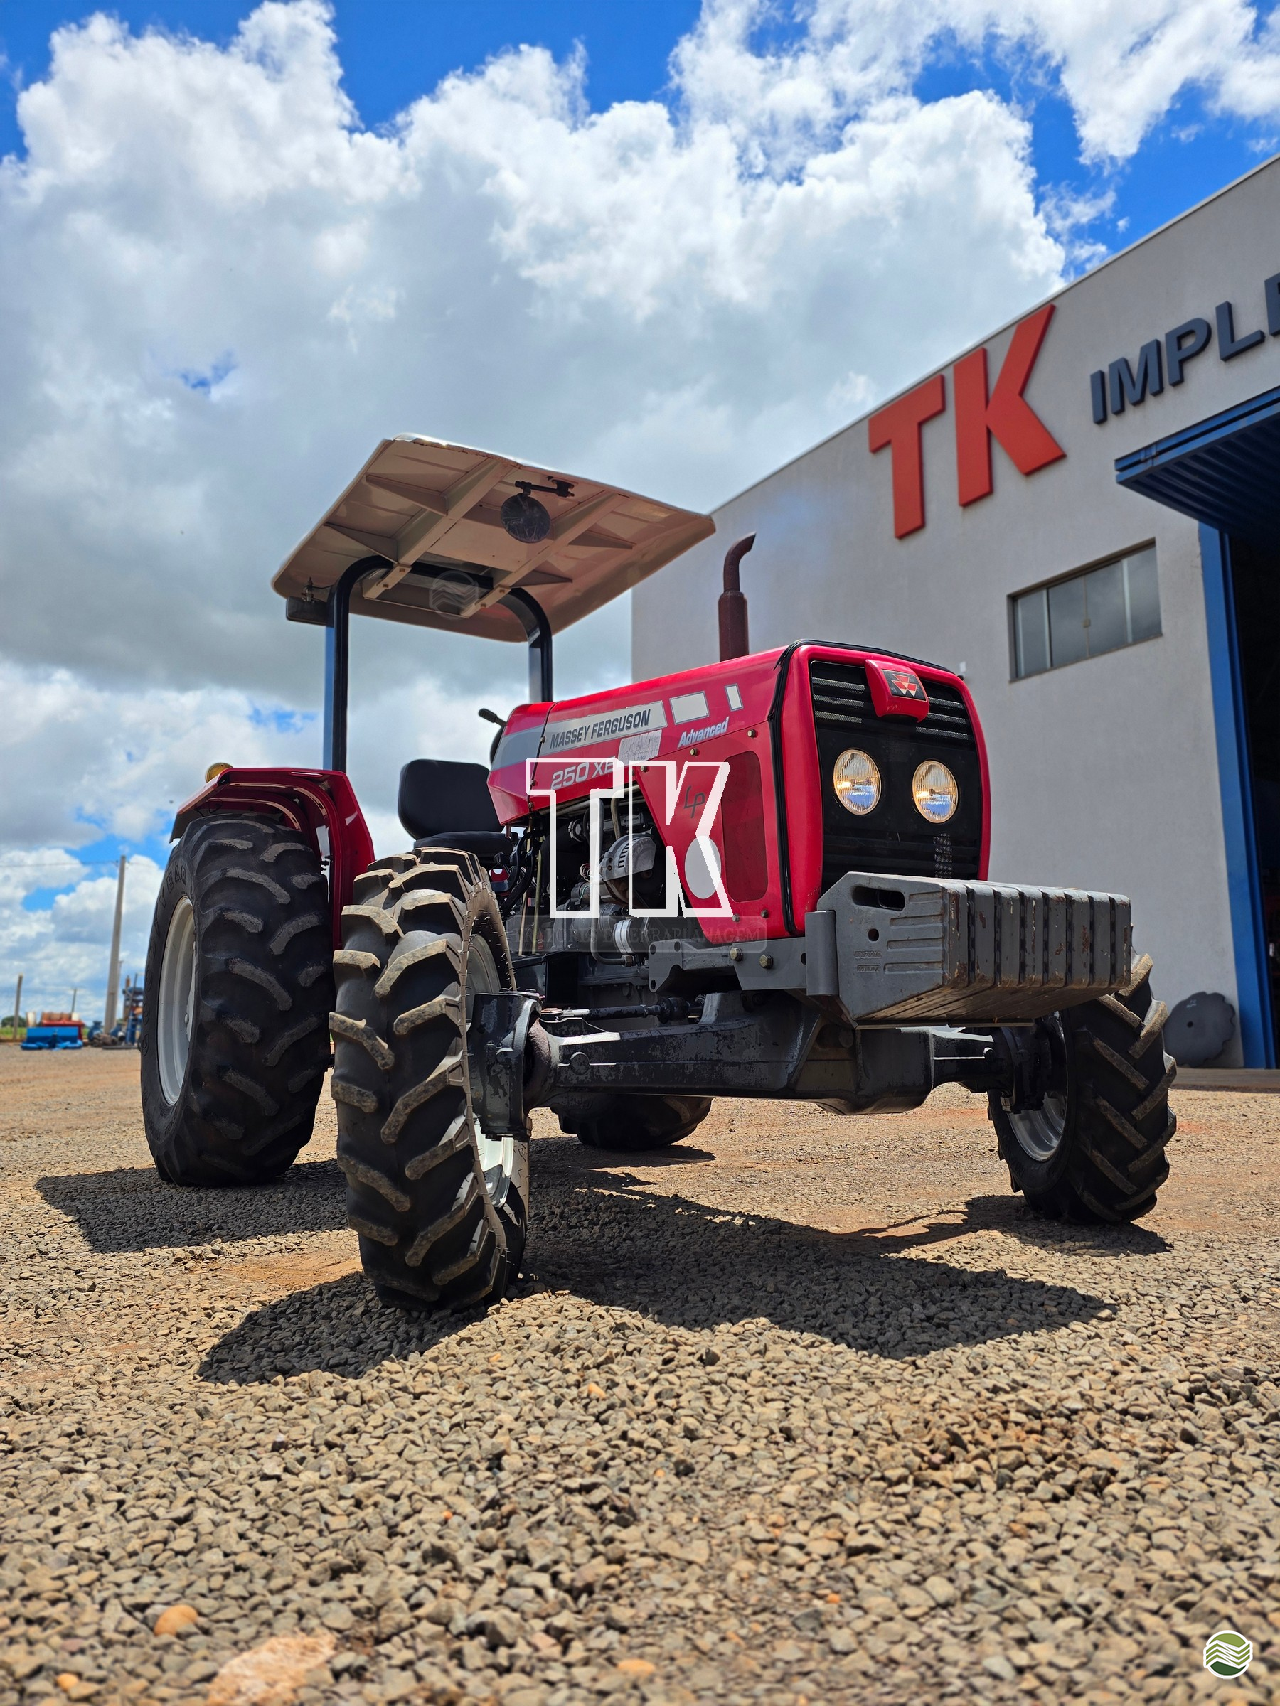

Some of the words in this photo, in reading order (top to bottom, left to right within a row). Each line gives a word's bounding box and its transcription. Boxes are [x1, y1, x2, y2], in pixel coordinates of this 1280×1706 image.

[868, 303, 1067, 540] TK
[550, 724, 591, 749] MASSEY
[591, 708, 651, 738] FERGUSON
[677, 716, 730, 750] Advanced
[551, 759, 590, 790] 250
